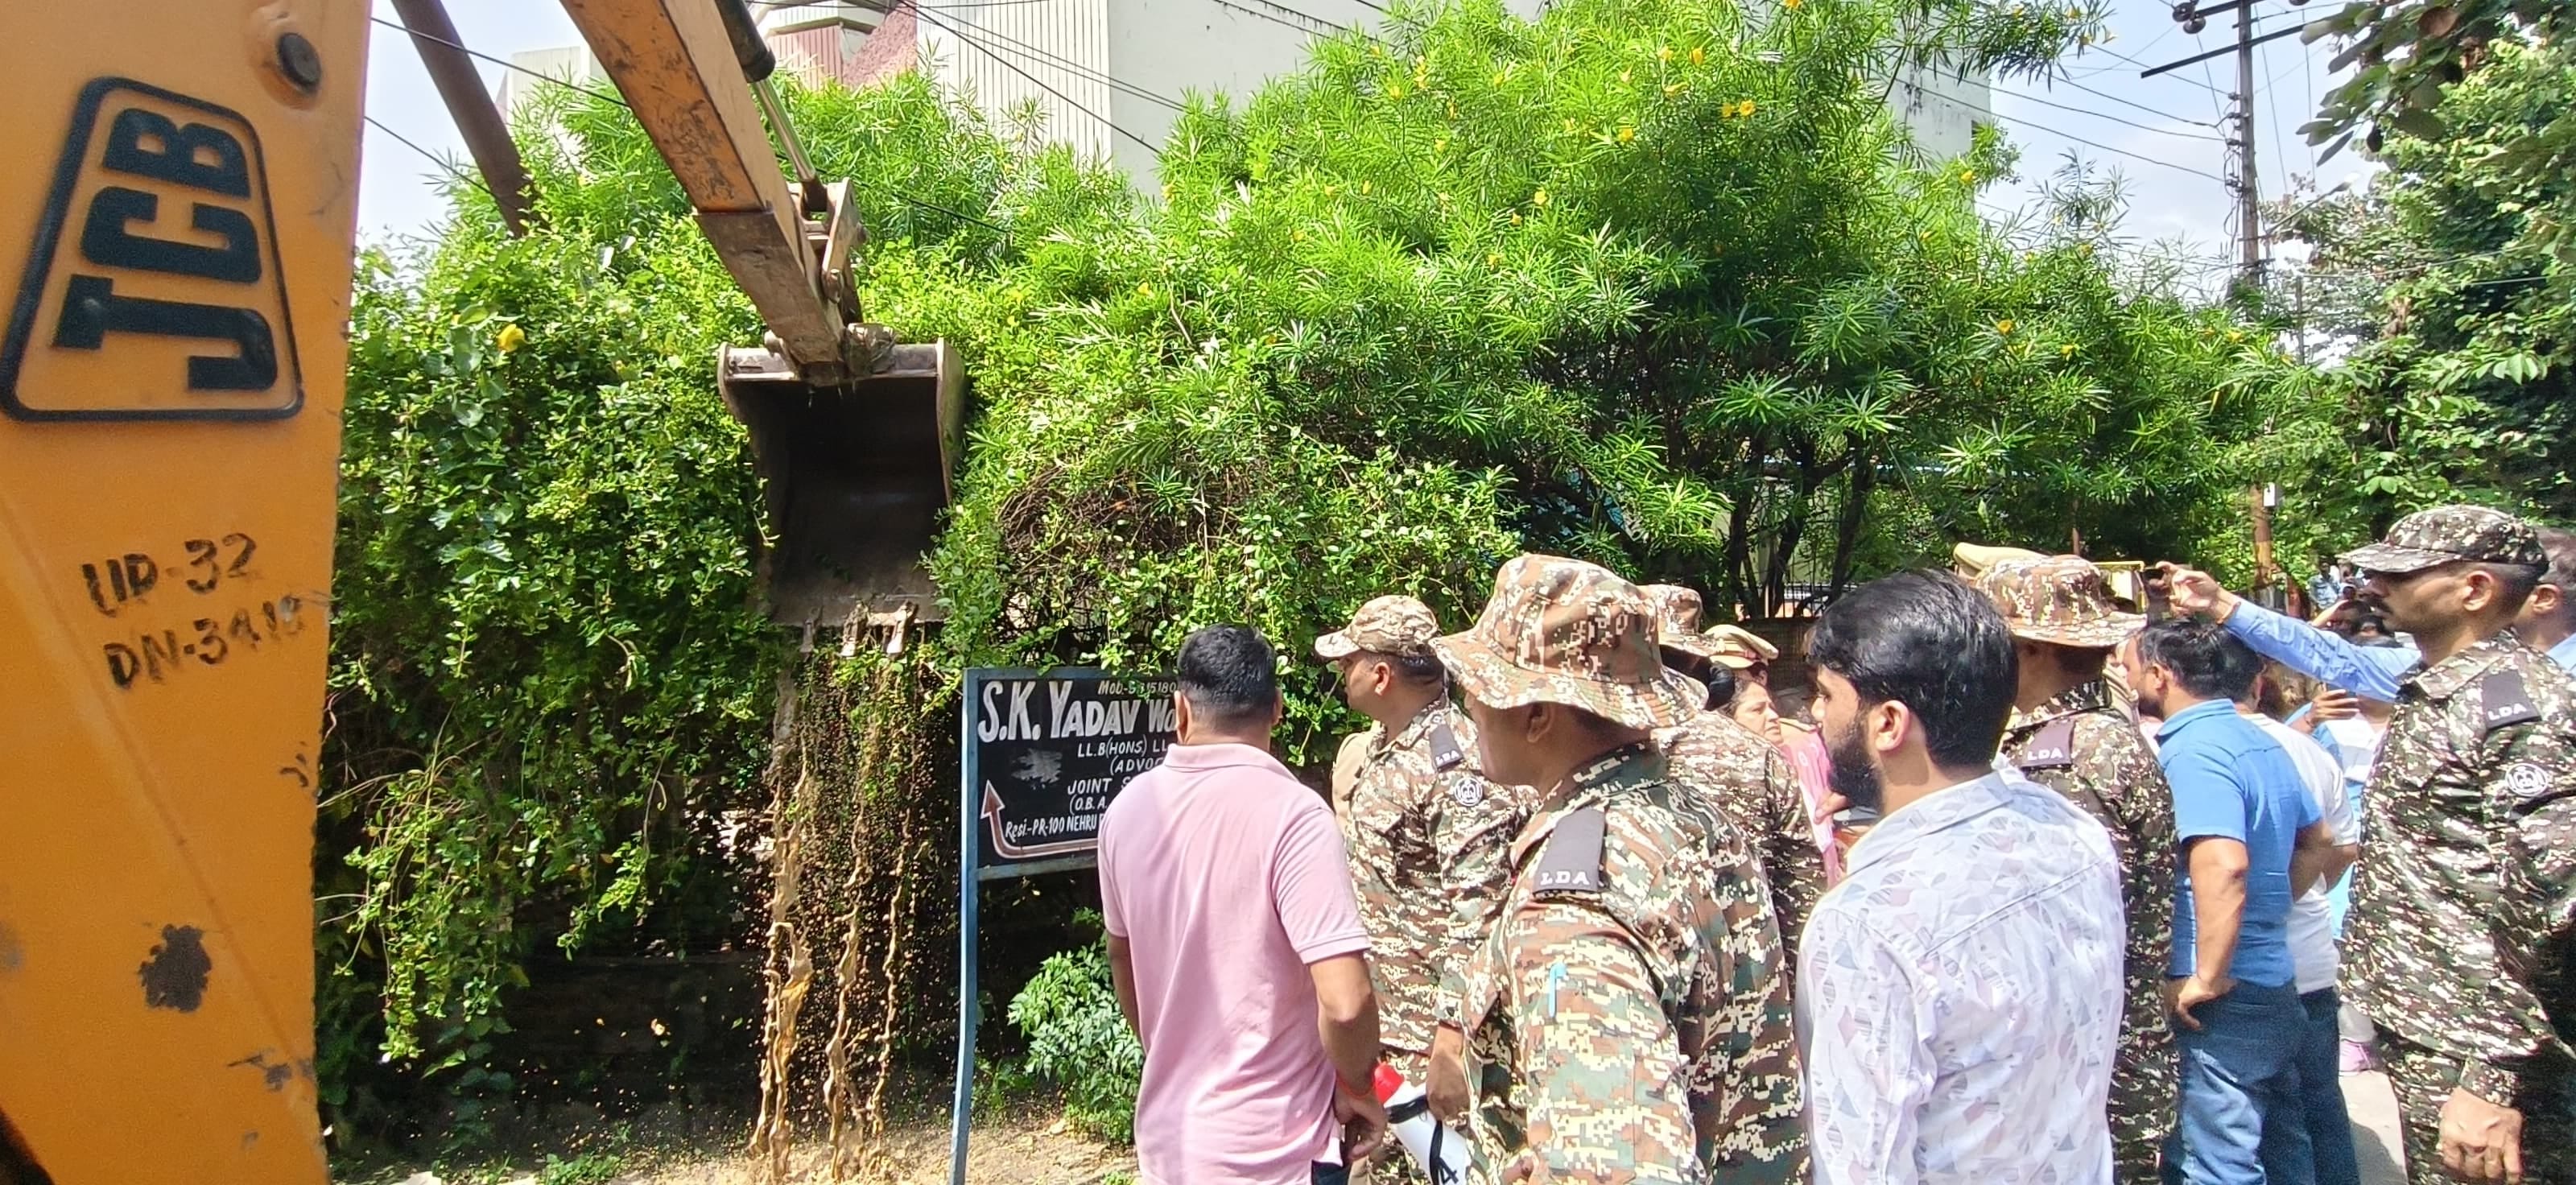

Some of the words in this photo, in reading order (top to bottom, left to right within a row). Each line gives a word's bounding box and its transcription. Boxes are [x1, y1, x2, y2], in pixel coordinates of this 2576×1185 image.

[52, 108, 278, 390] JCB
[977, 680, 1042, 743] S.K.
[1049, 679, 1141, 738] YADAV
[2487, 702, 2528, 721] LDA
[1435, 749, 1459, 766] LDA
[2027, 747, 2063, 761] LDA
[1067, 777, 1113, 795] JOINT
[1066, 813, 1097, 832] NEHRU
[1539, 870, 1591, 886] LDA
